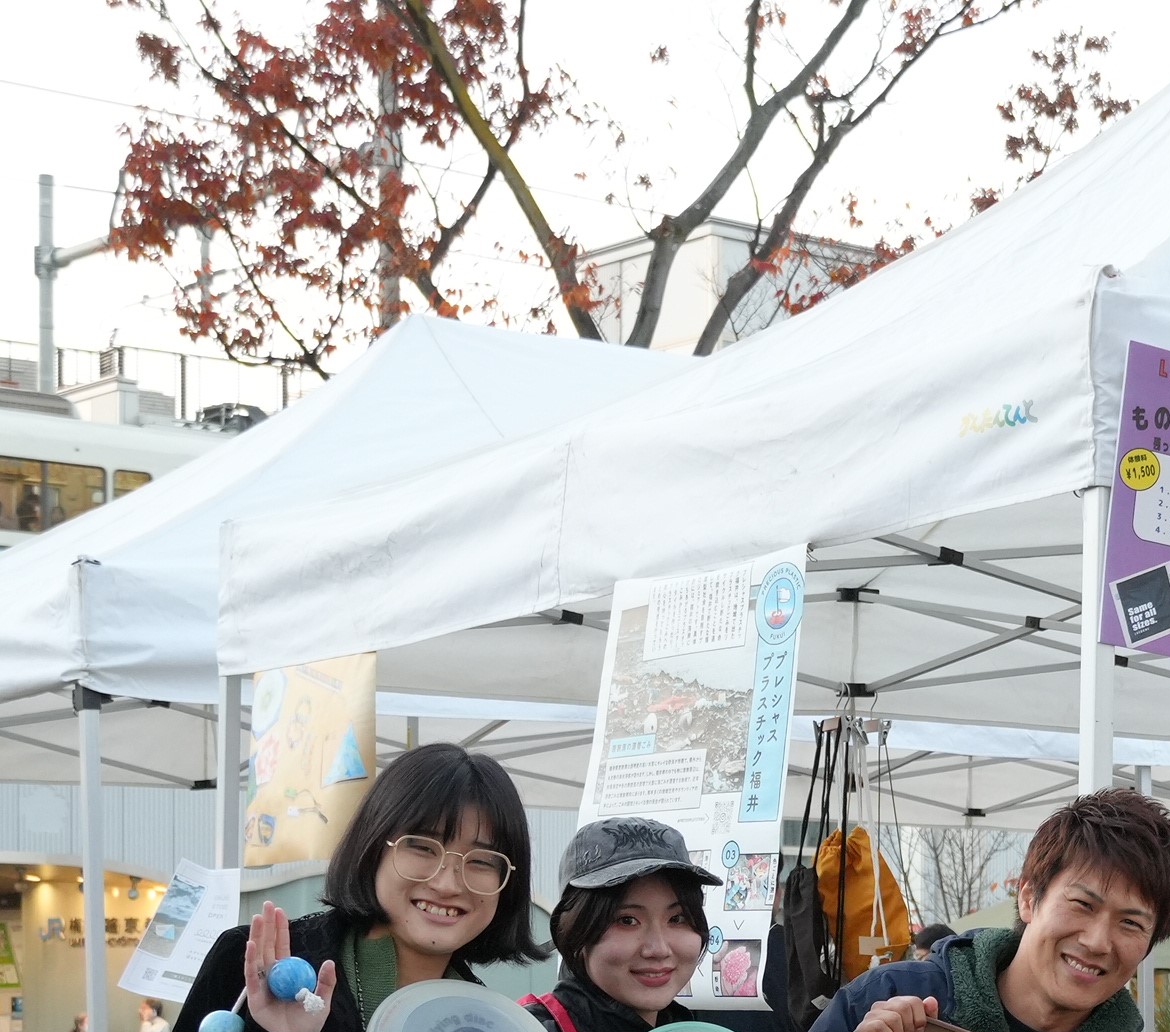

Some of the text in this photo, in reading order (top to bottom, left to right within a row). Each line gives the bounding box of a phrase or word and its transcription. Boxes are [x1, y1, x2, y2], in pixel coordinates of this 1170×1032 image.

[1126, 465, 1156, 480] ¥1,500
[761, 567, 802, 596] PRECIOUS PLASTIC
[1128, 601, 1154, 616] Same
[1130, 607, 1157, 624] for all
[1132, 617, 1158, 632] sizes.
[769, 632, 786, 640] FUKUI
[767, 652, 788, 742] プレシャス
[725, 850, 736, 860] 03
[709, 935, 720, 946] 04
